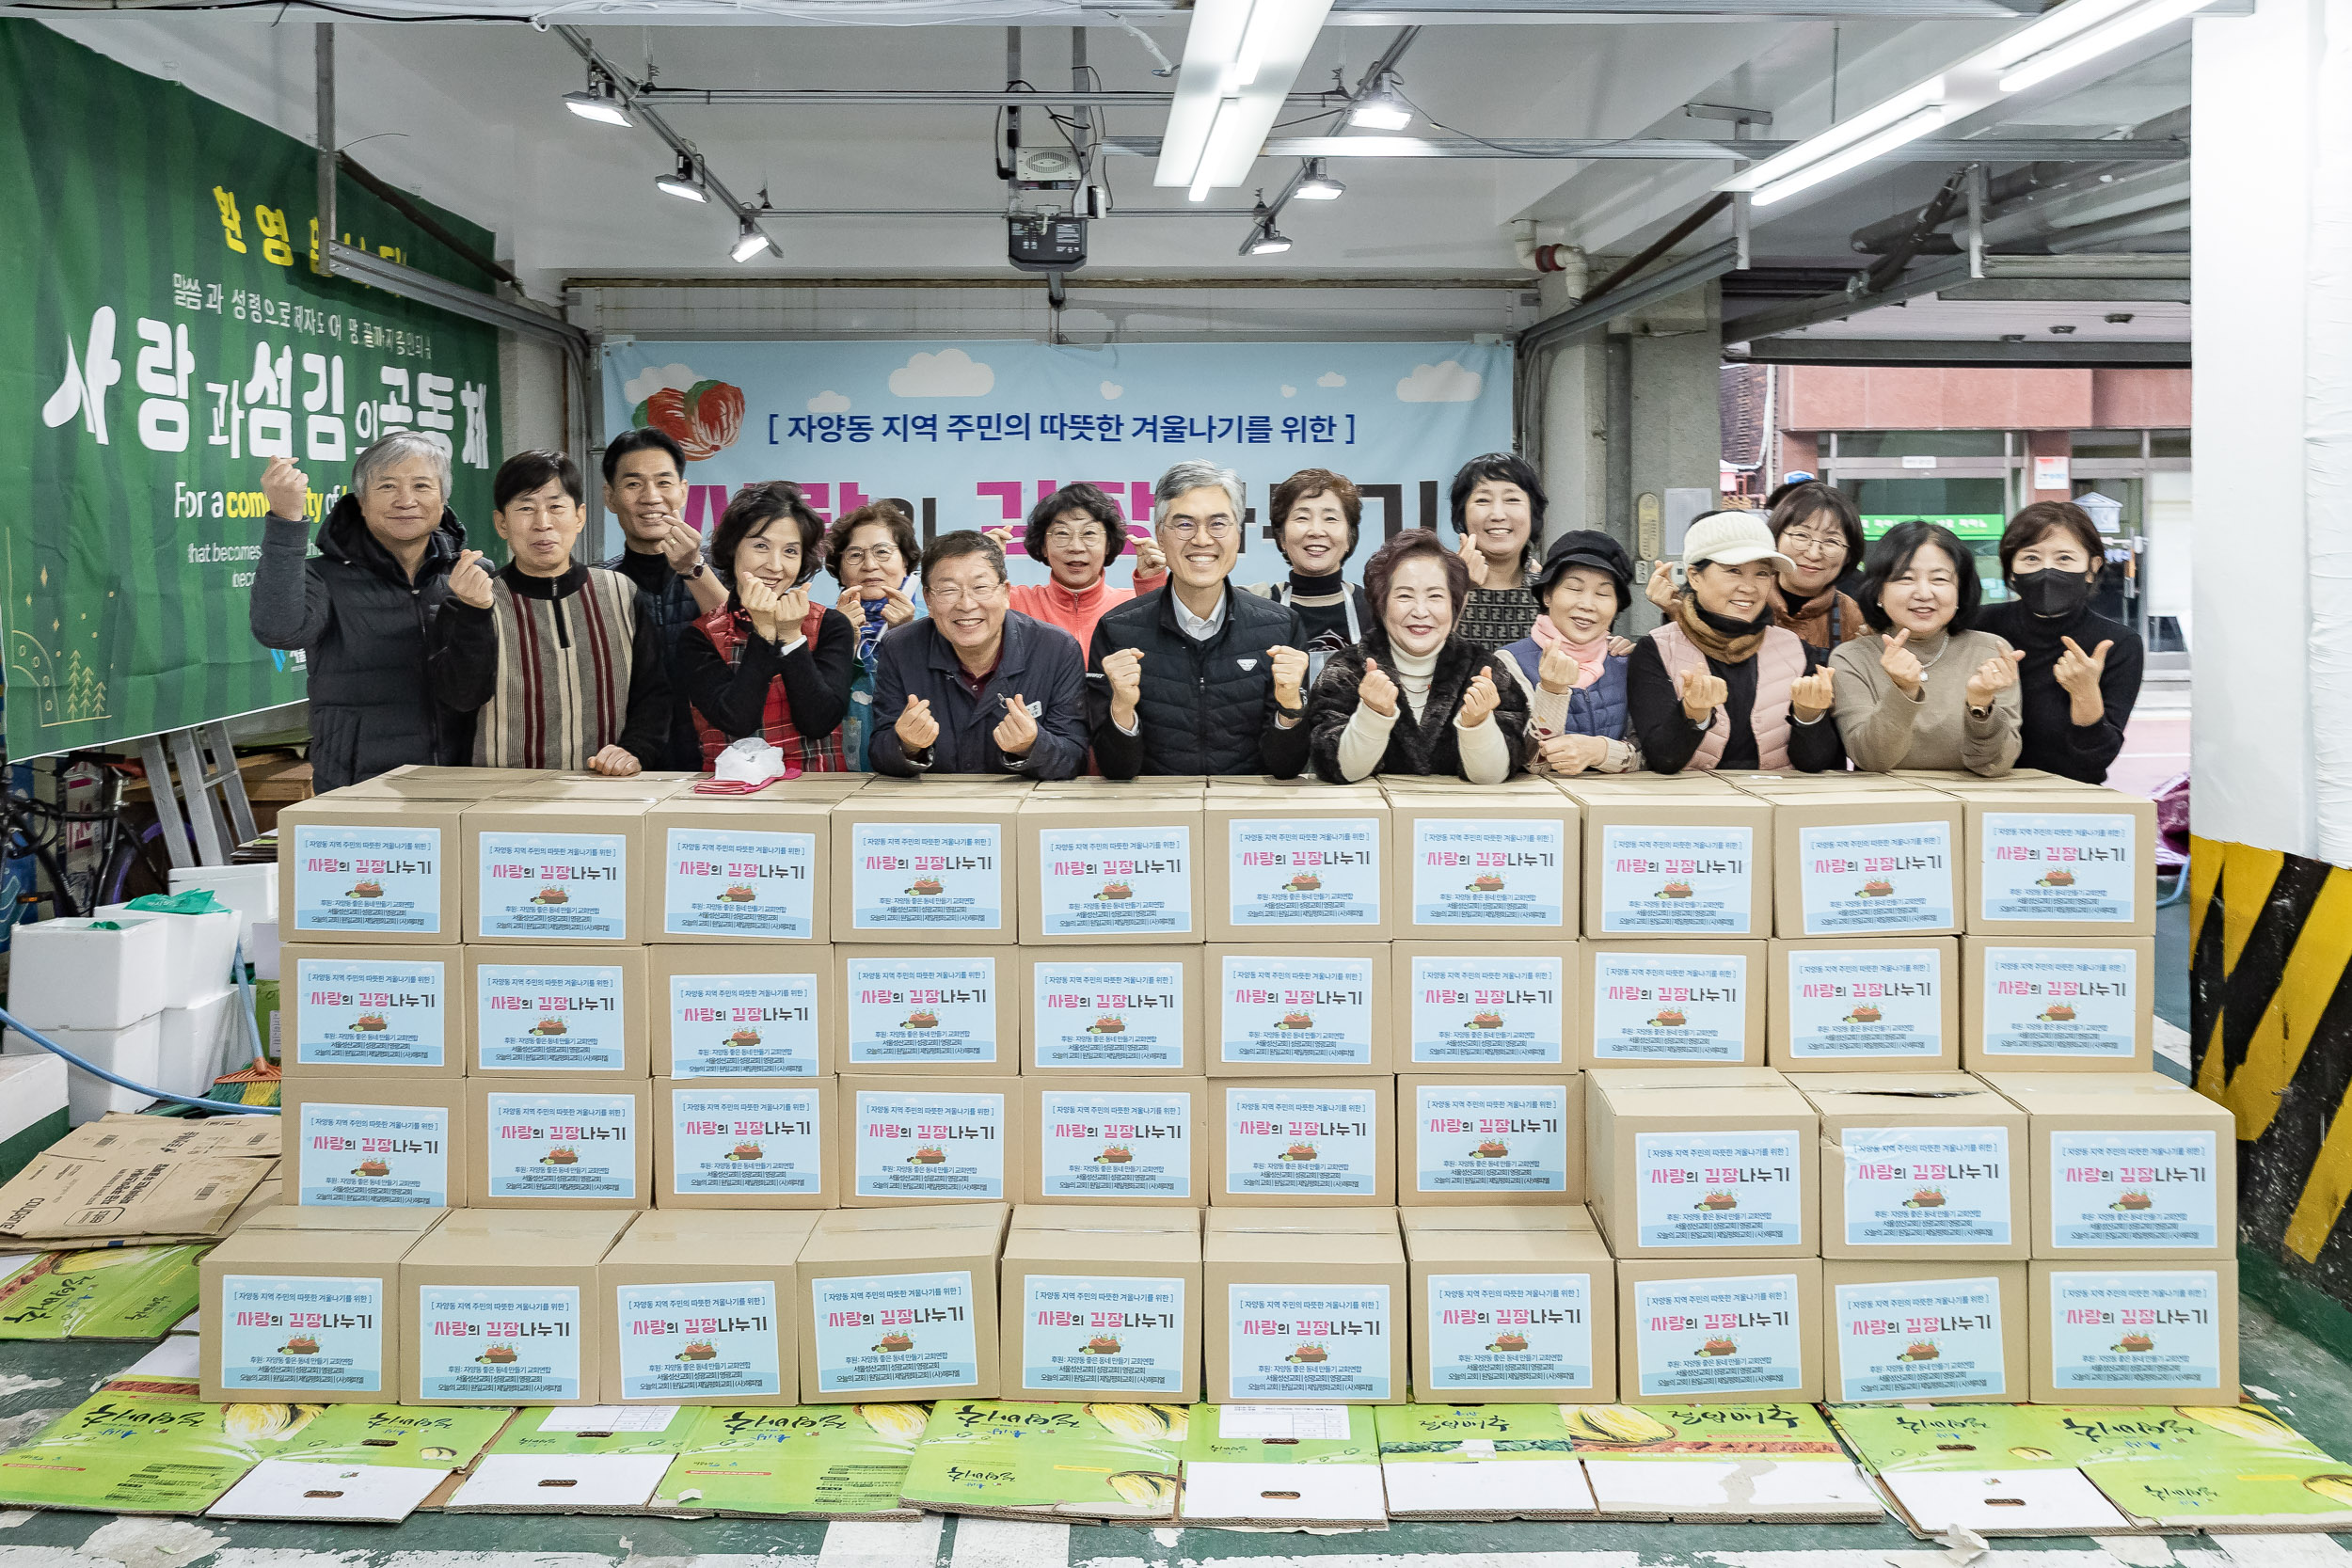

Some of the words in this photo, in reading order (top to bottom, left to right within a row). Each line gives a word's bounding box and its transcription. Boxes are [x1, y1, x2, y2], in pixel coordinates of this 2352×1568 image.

[42, 306, 245, 459] 사랑과
[787, 414, 874, 443] 자양동
[882, 414, 938, 442] 지역
[946, 412, 1030, 442] 주민의
[1040, 412, 1124, 442] 따뜻한
[1132, 414, 1273, 444] 겨울나기를
[1280, 415, 1337, 443] 위한
[175, 482, 207, 518] For
[211, 491, 224, 517] a
[226, 486, 324, 523] comty
[1243, 851, 1286, 866] 사랑의
[1292, 851, 1370, 865] 김장나누기
[1427, 851, 1470, 865] 사랑의
[1476, 852, 1553, 866] 김장나누기
[1996, 846, 2040, 861] 사랑의
[2046, 847, 2124, 862] 김장나누기
[308, 858, 350, 873] 사랑의
[356, 860, 431, 875] 김장나누기
[679, 861, 723, 876] 사랑의
[728, 863, 804, 879] 김장나누기
[866, 856, 909, 870] 사랑의
[914, 856, 992, 870] 김장나누기
[1055, 861, 1097, 876] 사랑의
[1103, 859, 1181, 875] 김장나누기
[1616, 859, 1659, 873] 사랑의
[1665, 860, 1742, 874] 김장나누기
[1815, 858, 1858, 874] 사랑의
[1864, 855, 1942, 872] 김장나누기
[493, 864, 534, 879] 사랑의
[540, 865, 616, 880] 김장나누기
[1609, 986, 1652, 1001] 사랑의
[1658, 988, 1736, 1003] 김장나누기
[1804, 983, 1846, 998] 사랑의
[1852, 982, 1931, 998] 김장나누기
[1998, 980, 2042, 995] 사랑의
[2047, 982, 2126, 996] 김장나누기
[311, 991, 353, 1006] 사랑의
[358, 992, 435, 1007] 김장나누기
[491, 996, 532, 1010] 사랑의
[538, 997, 613, 1011] 김장나누기
[862, 990, 903, 1004] 사랑의
[910, 990, 986, 1004] 김장나누기
[1048, 994, 1090, 1008] 사랑의
[1096, 994, 1173, 1008] 김장나누기
[1235, 990, 1279, 1004] 사랑의
[1284, 990, 1362, 1005] 김장나누기
[1425, 990, 1469, 1004] 사랑의
[1474, 990, 1552, 1004] 김장나누기
[684, 1007, 726, 1022] 사랑의
[732, 1007, 808, 1022] 김장나누기
[501, 1125, 544, 1139] 사랑의
[549, 1126, 626, 1140] 김장나누기
[687, 1121, 728, 1135] 사랑의
[734, 1121, 810, 1135] 김장나누기
[869, 1124, 912, 1138] 사랑의
[917, 1125, 994, 1140] 김장나누기
[1056, 1124, 1098, 1138] 사랑의
[1104, 1125, 1181, 1139] 김장나누기
[1240, 1121, 1282, 1135] 사랑의
[1289, 1122, 1366, 1136] 김장나누기
[1430, 1118, 1473, 1132] 사랑의
[1479, 1119, 1557, 1132] 김장나누기
[313, 1135, 356, 1150] 사랑의
[361, 1138, 438, 1154] 김장나누기
[1651, 1168, 1698, 1184] 사랑의
[1705, 1167, 1789, 1183] 김장나누기
[1858, 1164, 1906, 1180] 사랑의
[1913, 1164, 1999, 1180] 김장나누기
[2066, 1167, 2113, 1182] 사랑의
[2121, 1167, 2205, 1183] 김장나누기
[237, 1311, 283, 1327] 사랑의
[289, 1313, 372, 1329] 김장나누기
[828, 1310, 874, 1328] 사랑의
[881, 1307, 963, 1325] 김장나누기
[1038, 1310, 1084, 1326] 사랑의
[1090, 1312, 1174, 1328] 김장나누기
[1443, 1309, 1489, 1324] 사랑의
[1496, 1308, 1581, 1324] 김장나누기
[1651, 1315, 1697, 1332] 사랑의
[1704, 1311, 1788, 1330] 김장나누기
[2067, 1309, 2114, 1324] 사랑의
[2122, 1309, 2207, 1324] 김장나누기
[435, 1322, 480, 1337] 사랑의
[486, 1322, 569, 1337] 김장나누기
[633, 1319, 678, 1336] 사랑의
[684, 1316, 767, 1334] 김장나누기
[1244, 1320, 1290, 1335] 사랑의
[1296, 1321, 1380, 1336] 김장나누기
[1852, 1319, 1899, 1336] 사랑의
[1906, 1314, 1991, 1334] 김장나누기
[81, 1402, 206, 1431] 절임배추
[723, 1410, 848, 1435] 절임배추
[954, 1404, 1080, 1431] 절임배추
[1418, 1411, 1510, 1433] 절임배추
[1668, 1403, 1800, 1429] 절임배추
